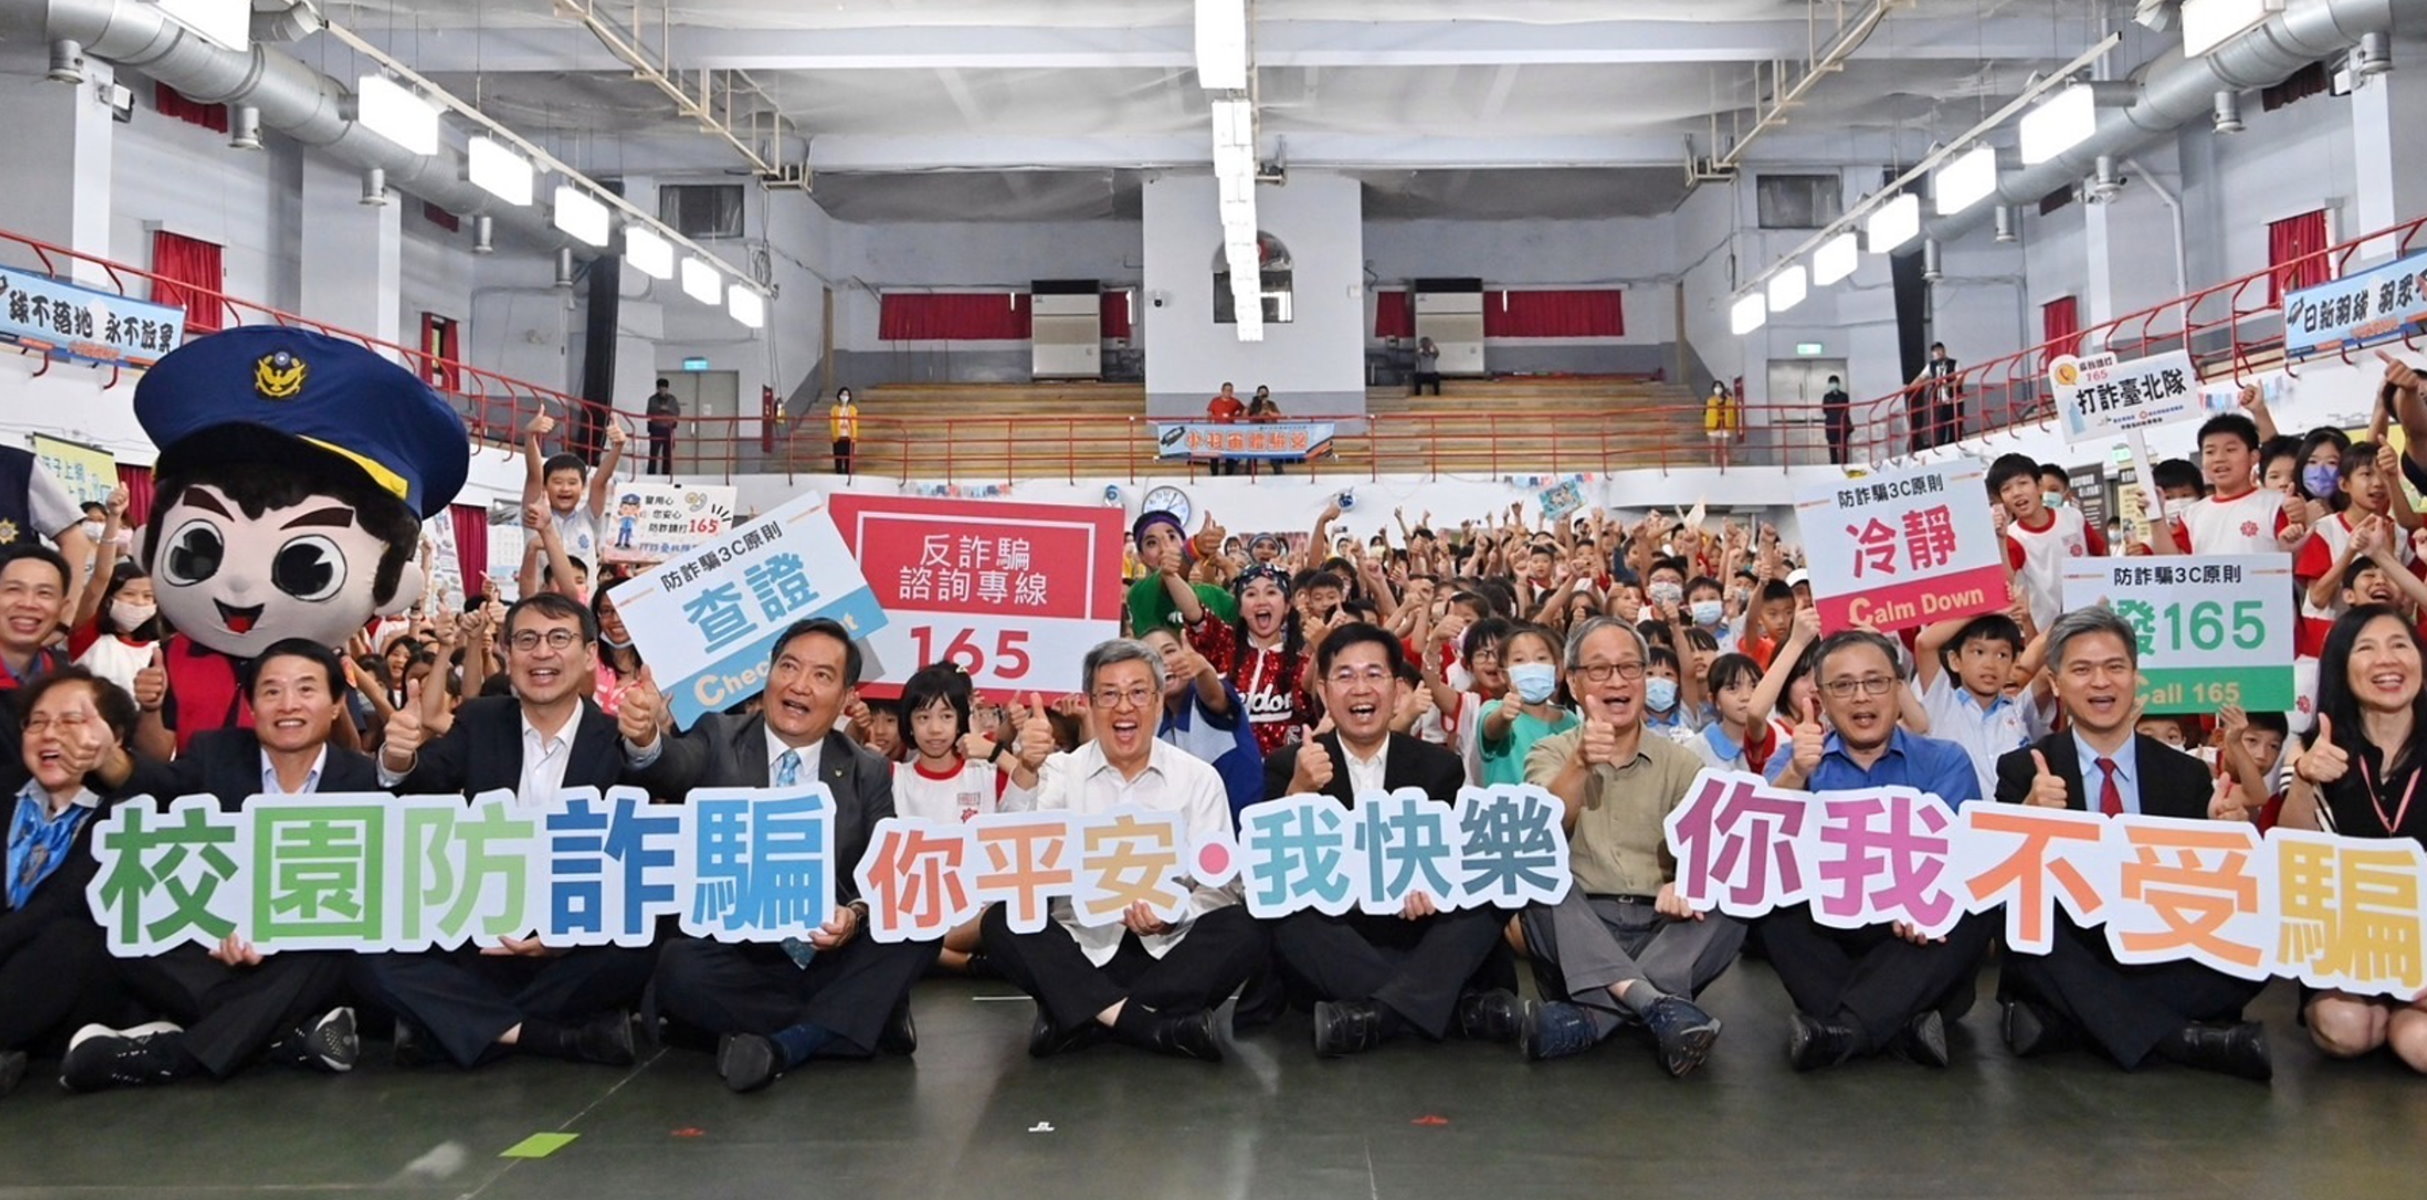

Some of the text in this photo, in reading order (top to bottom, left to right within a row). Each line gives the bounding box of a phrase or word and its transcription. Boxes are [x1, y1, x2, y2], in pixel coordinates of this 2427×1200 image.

[105, 313, 174, 352] 永不放棄
[2076, 368, 2187, 415] 打詐臺北隊
[1837, 473, 1944, 509] 防詐騙3C原則
[660, 521, 783, 592] 防詐騙3C原則
[920, 534, 1030, 571] 反詐騙
[1846, 504, 1957, 579] 冷靜
[899, 566, 1047, 605] 諮詢專線
[2114, 565, 2242, 585] 防詐騙3C原則
[682, 552, 820, 654] 查證
[1849, 588, 1985, 627] Calm Down
[910, 625, 1031, 680] 165
[694, 654, 770, 707] Chec
[2193, 682, 2241, 704] 165
[99, 795, 824, 945] 校園防詐騙
[1677, 779, 2424, 988] 你我不受騙
